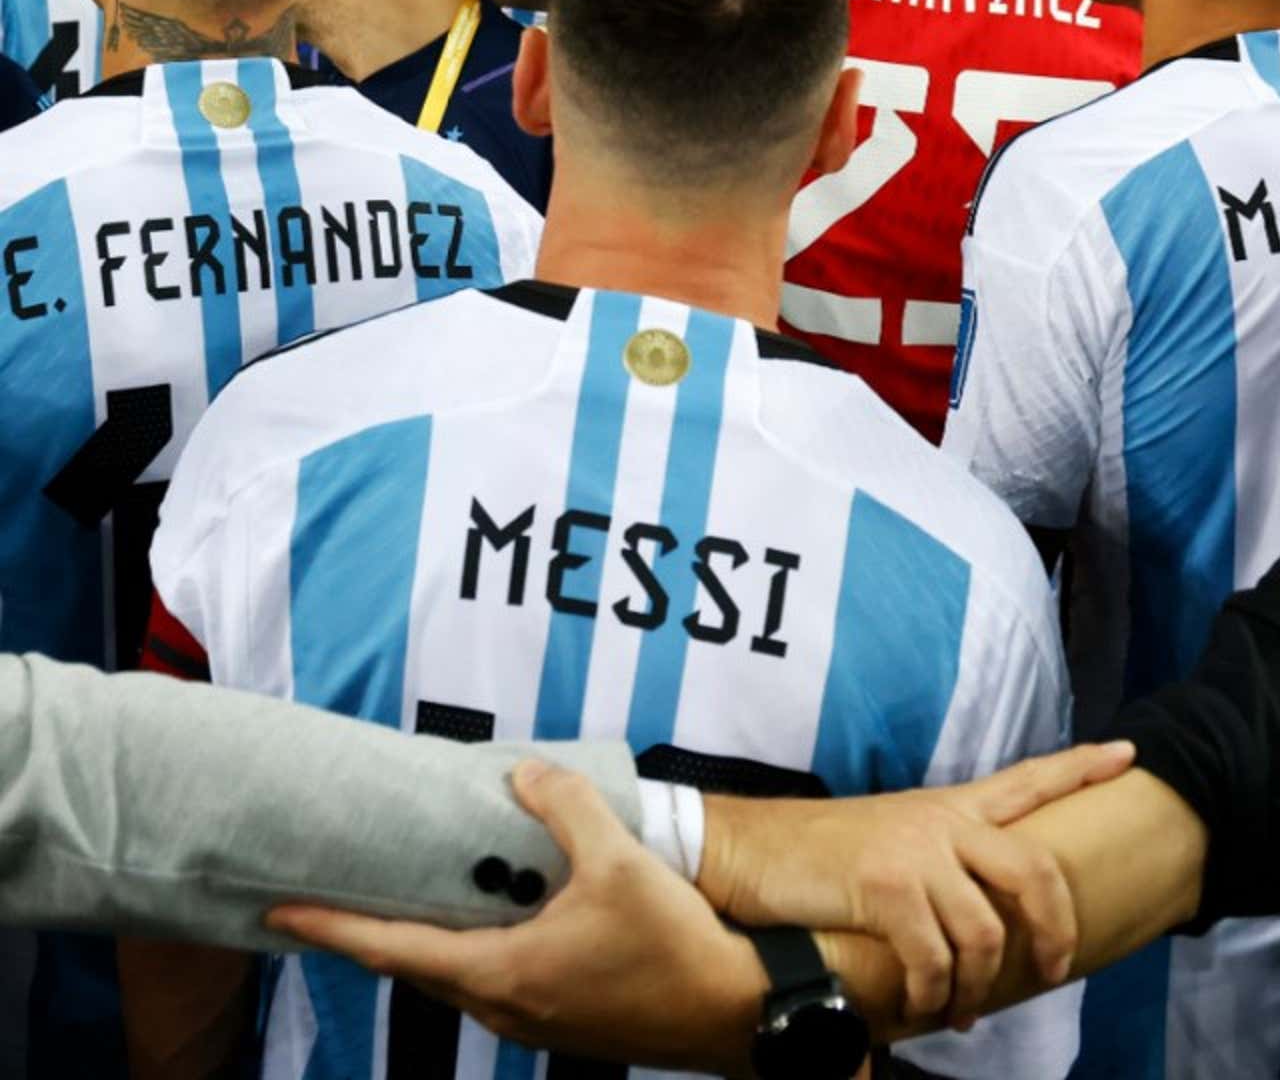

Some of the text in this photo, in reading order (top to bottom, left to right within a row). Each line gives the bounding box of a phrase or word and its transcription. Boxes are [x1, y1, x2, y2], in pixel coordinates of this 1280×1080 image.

[4, 199, 474, 320] E. FERNANDEZ
[459, 495, 801, 659] MESSI
